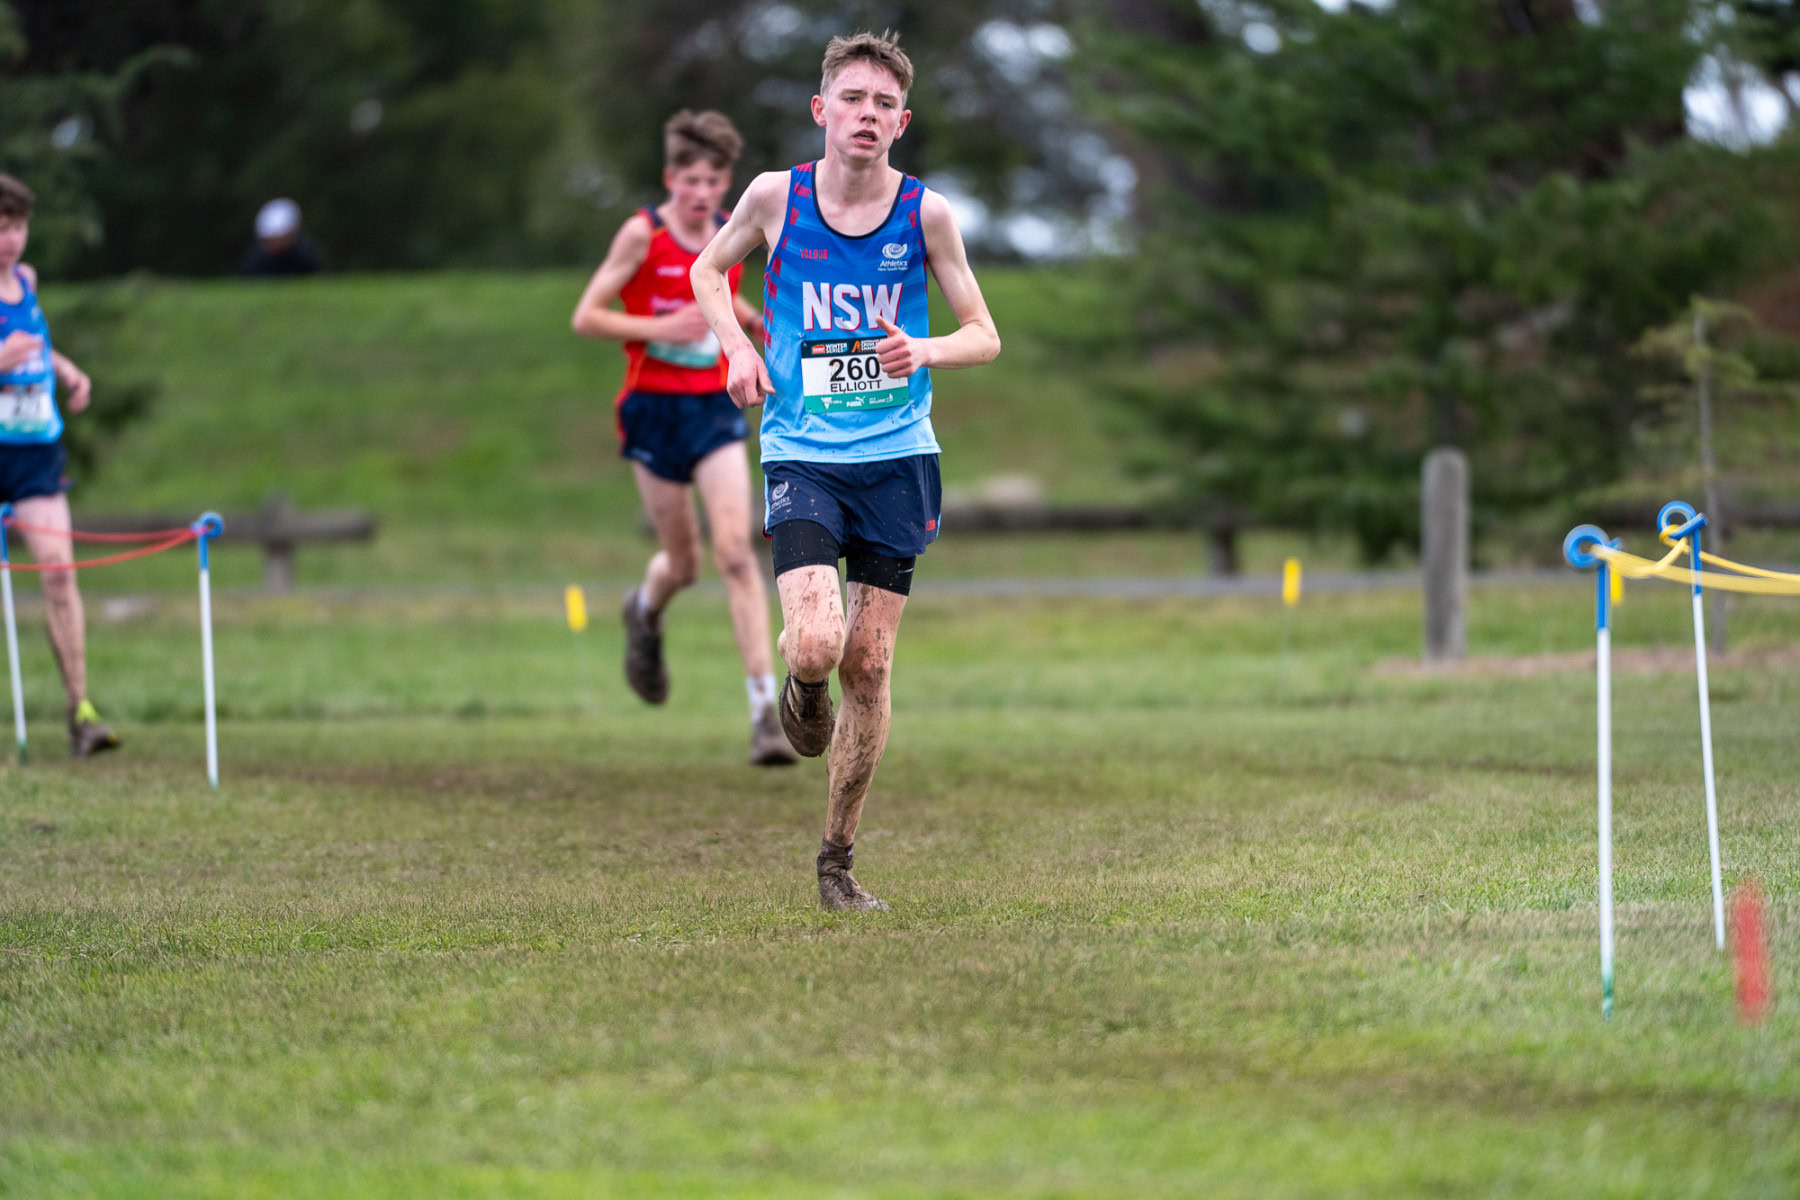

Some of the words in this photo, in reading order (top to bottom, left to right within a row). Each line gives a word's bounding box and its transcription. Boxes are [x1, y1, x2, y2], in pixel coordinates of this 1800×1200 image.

[800, 248, 828, 260] VALOUR
[802, 281, 903, 331] NSW
[829, 356, 880, 382] 260
[830, 379, 882, 393] ELLIOTT
